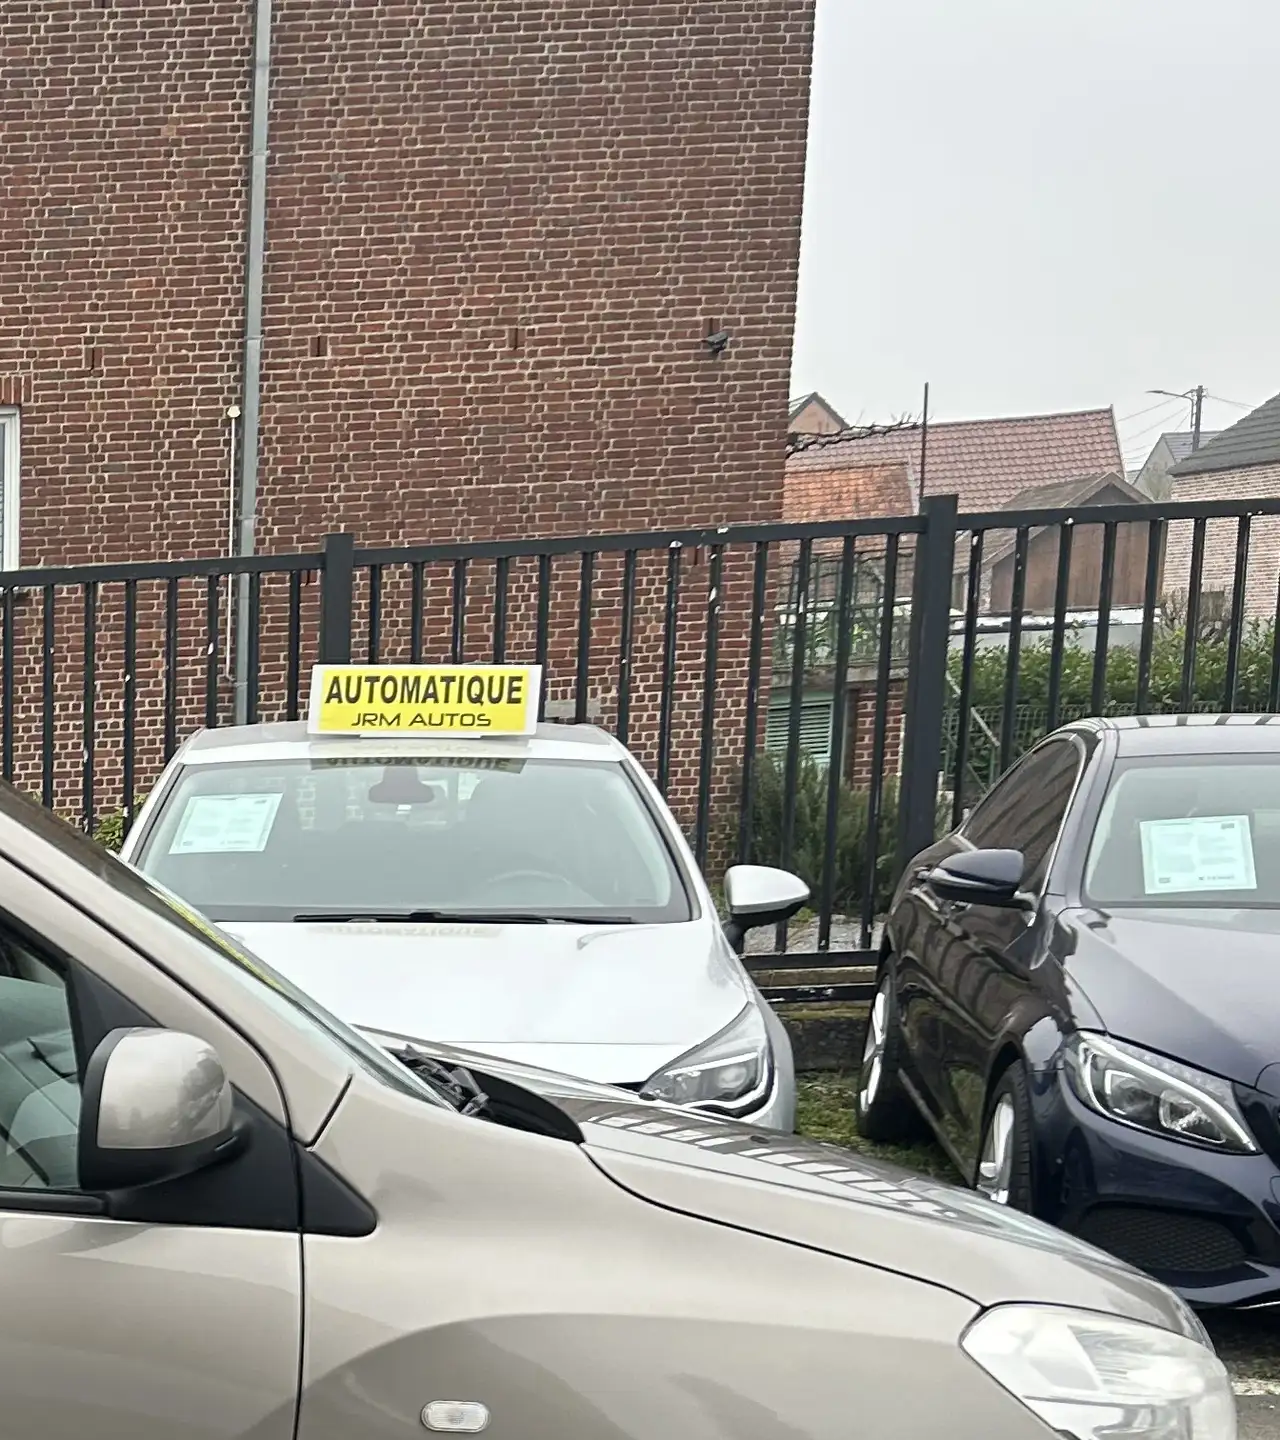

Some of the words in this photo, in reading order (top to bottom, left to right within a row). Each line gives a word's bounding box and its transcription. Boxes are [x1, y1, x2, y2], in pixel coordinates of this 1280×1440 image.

[324, 674, 524, 707] AUTOMATIQUE
[350, 712, 401, 727] JRM
[407, 712, 492, 727] AUTOS
